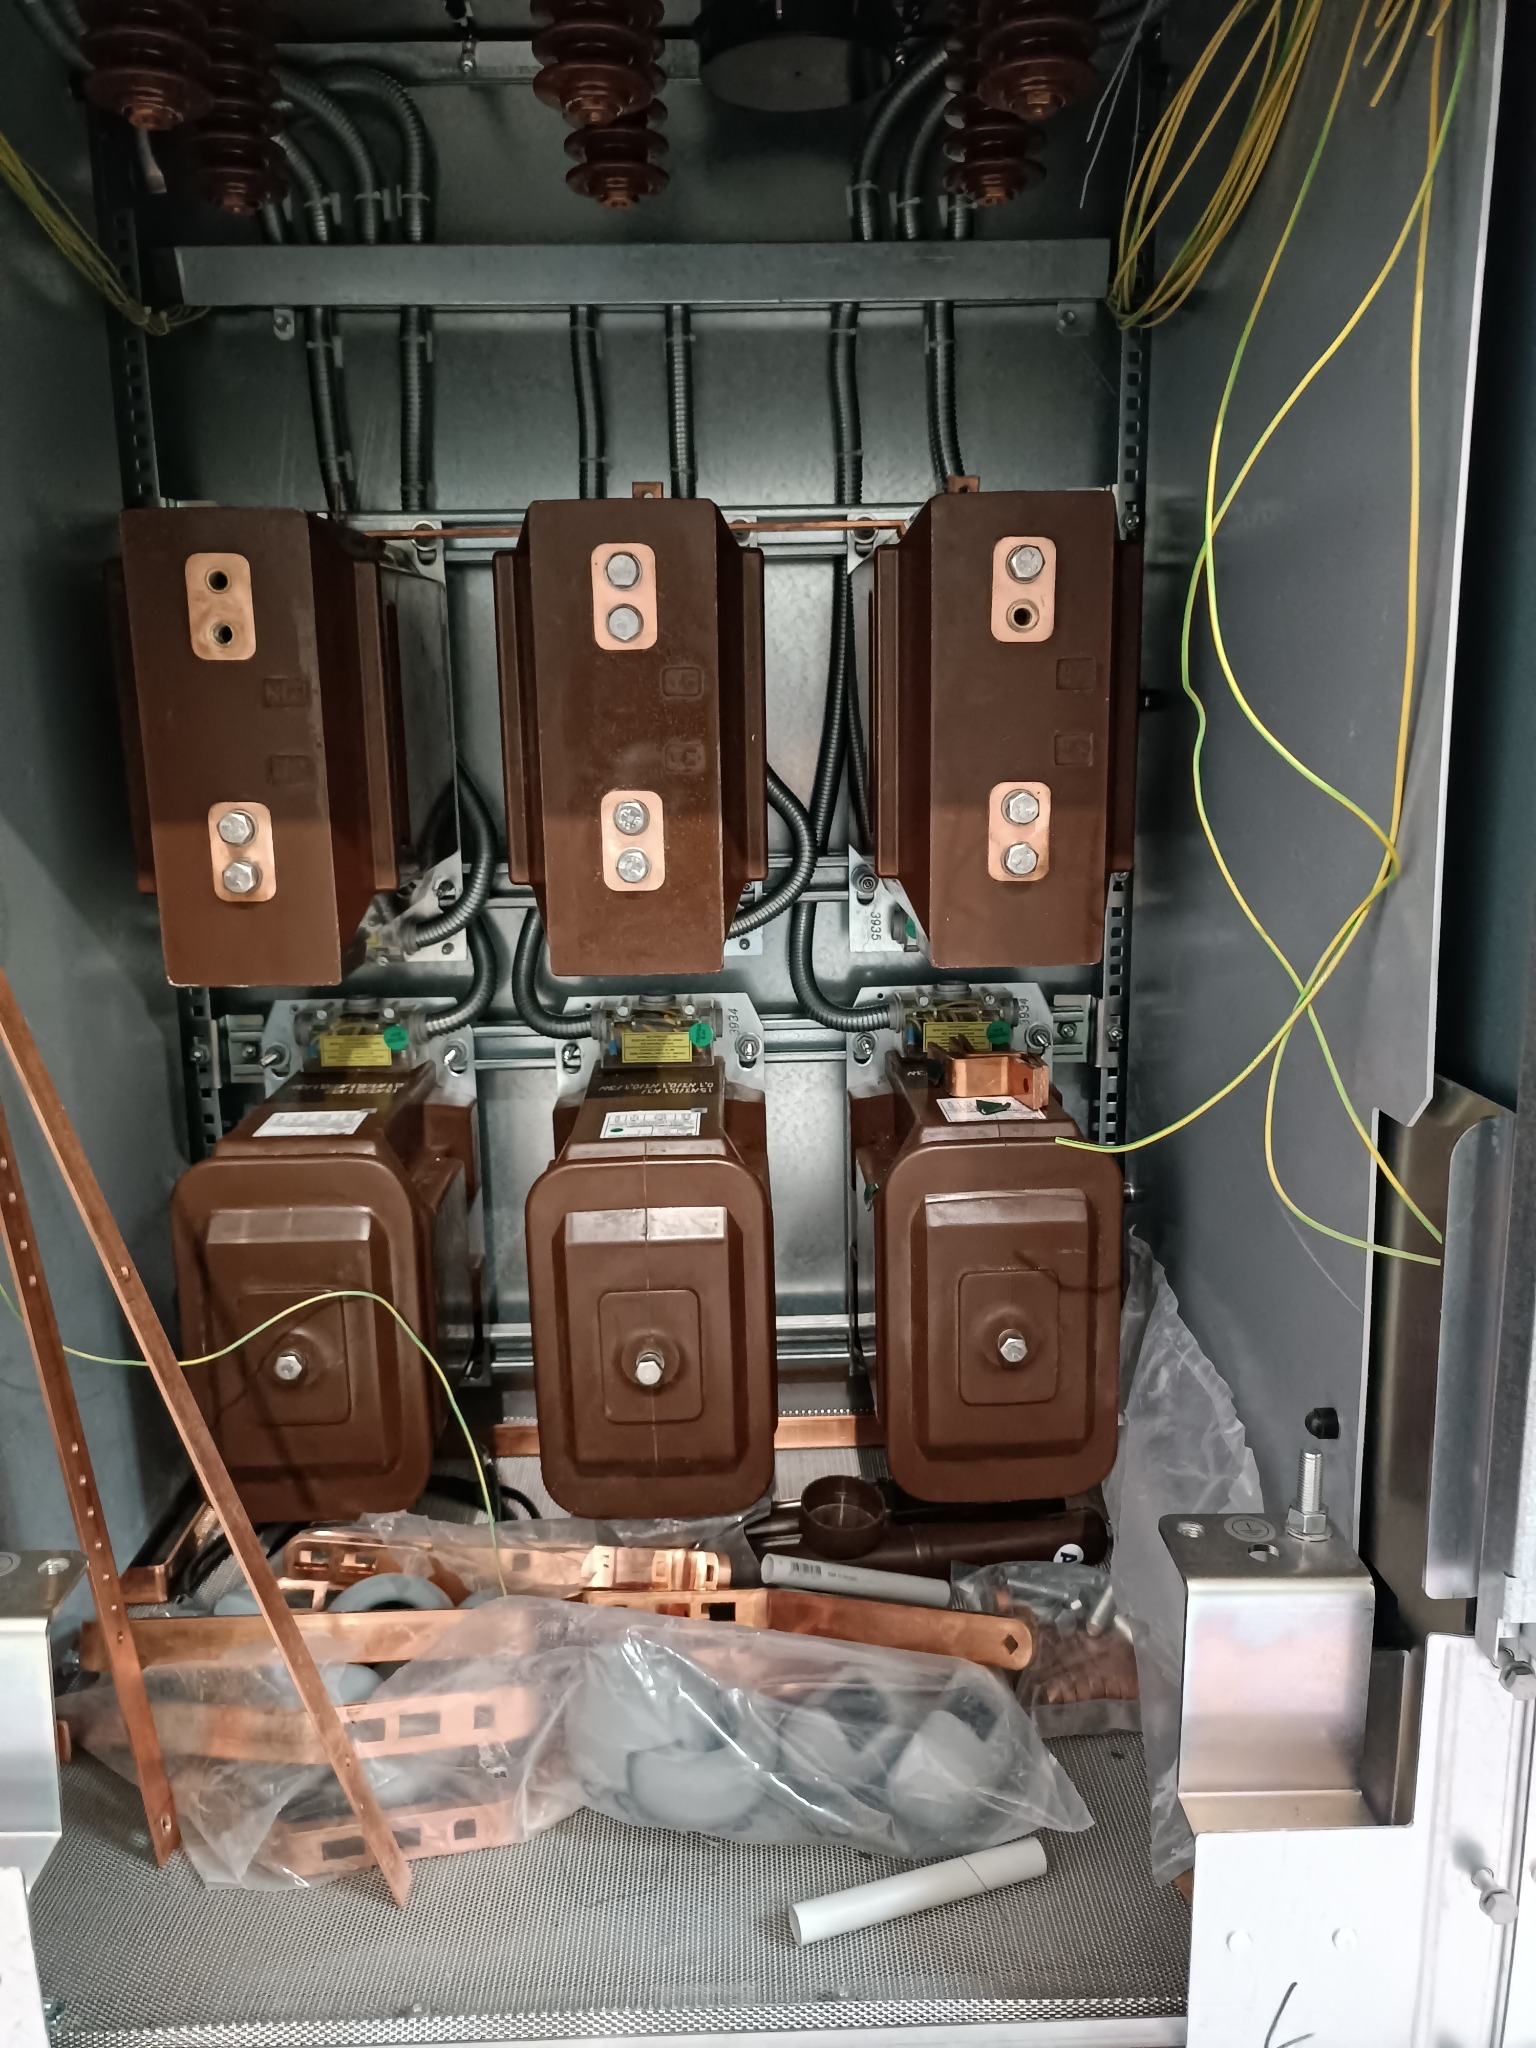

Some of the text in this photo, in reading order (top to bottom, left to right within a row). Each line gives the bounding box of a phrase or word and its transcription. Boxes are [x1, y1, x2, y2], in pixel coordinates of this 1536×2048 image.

[870, 911, 882, 941] 3935
[728, 1008, 740, 1036] 3934
[1019, 998, 1030, 1025] 3934
